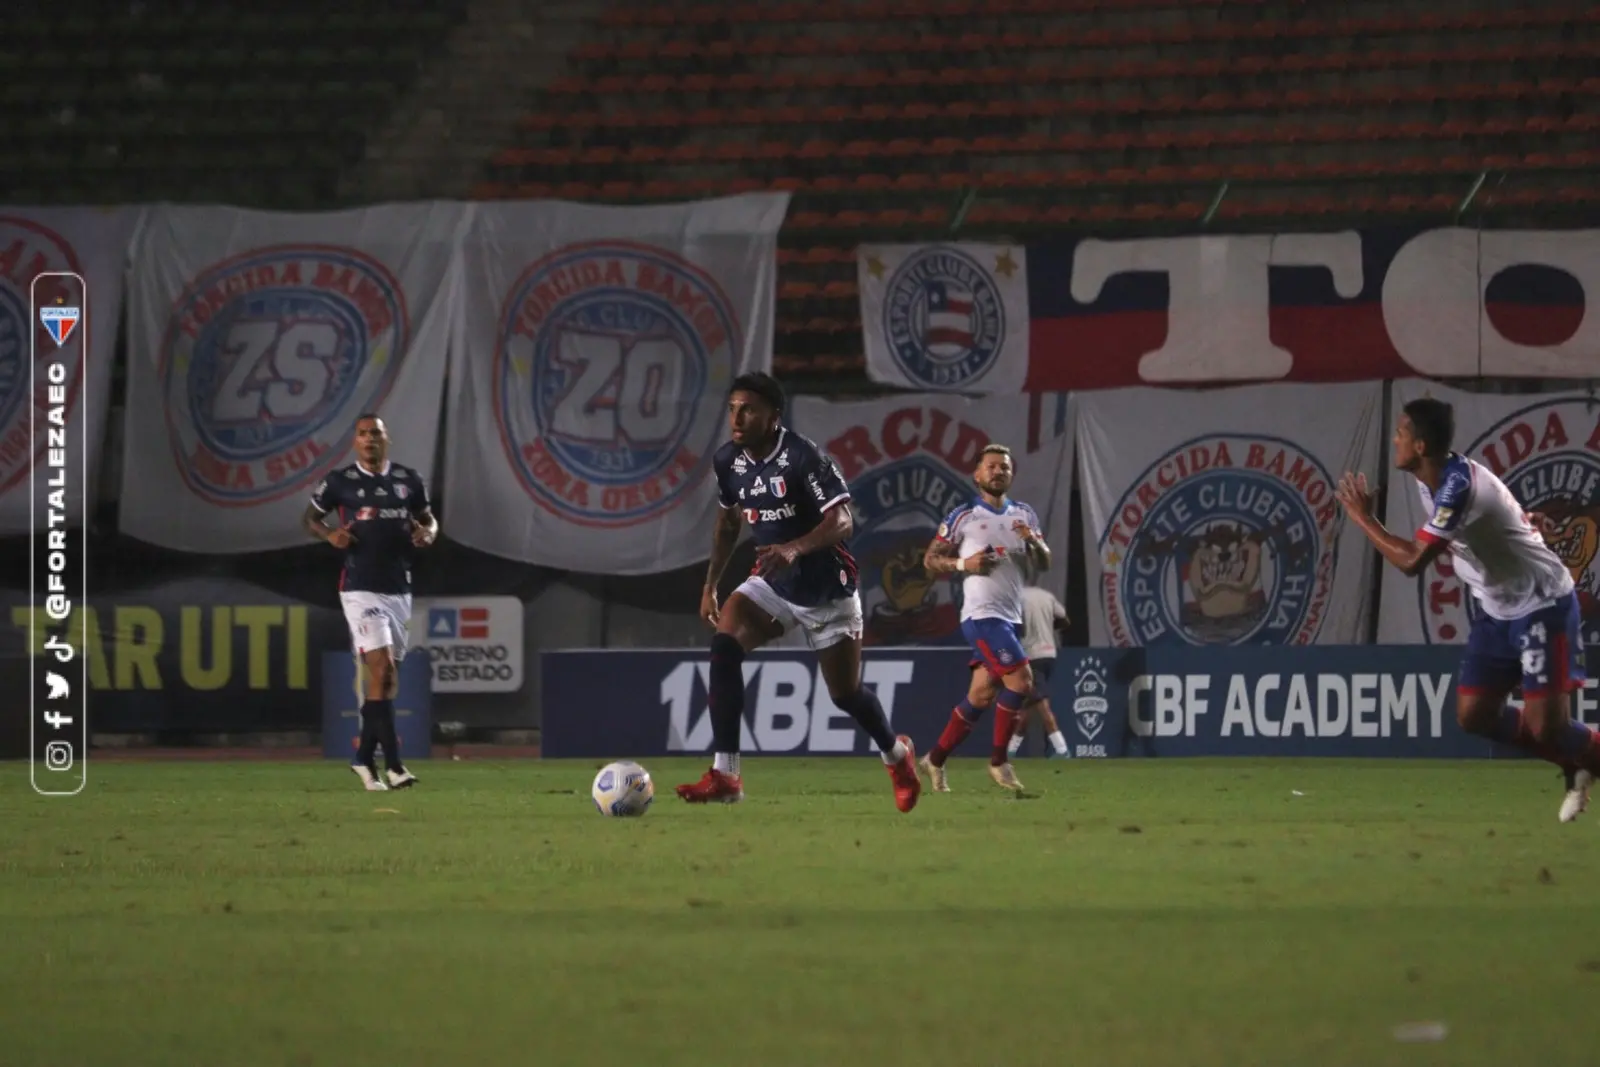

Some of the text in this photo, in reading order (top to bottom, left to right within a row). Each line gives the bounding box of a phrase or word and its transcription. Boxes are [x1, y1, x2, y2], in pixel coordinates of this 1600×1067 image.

[512, 260, 625, 339] TORCIDA
[212, 320, 339, 419] ZS
[265, 438, 331, 482] SUL
[521, 436, 589, 507] ZONA
[810, 481, 826, 501] MRV
[1109, 442, 1336, 547] TORCIDA BAMOR
[1520, 462, 1598, 503] CLUBE
[759, 503, 796, 522] zenir
[1199, 483, 1291, 527] CLUBE
[180, 605, 308, 690] UTI
[413, 645, 509, 662] OVERNO
[438, 664, 513, 681] ESTADO
[1128, 674, 1211, 738] CBF
[1220, 674, 1452, 738] ACADEMY
[1076, 745, 1107, 757] BRASIL
